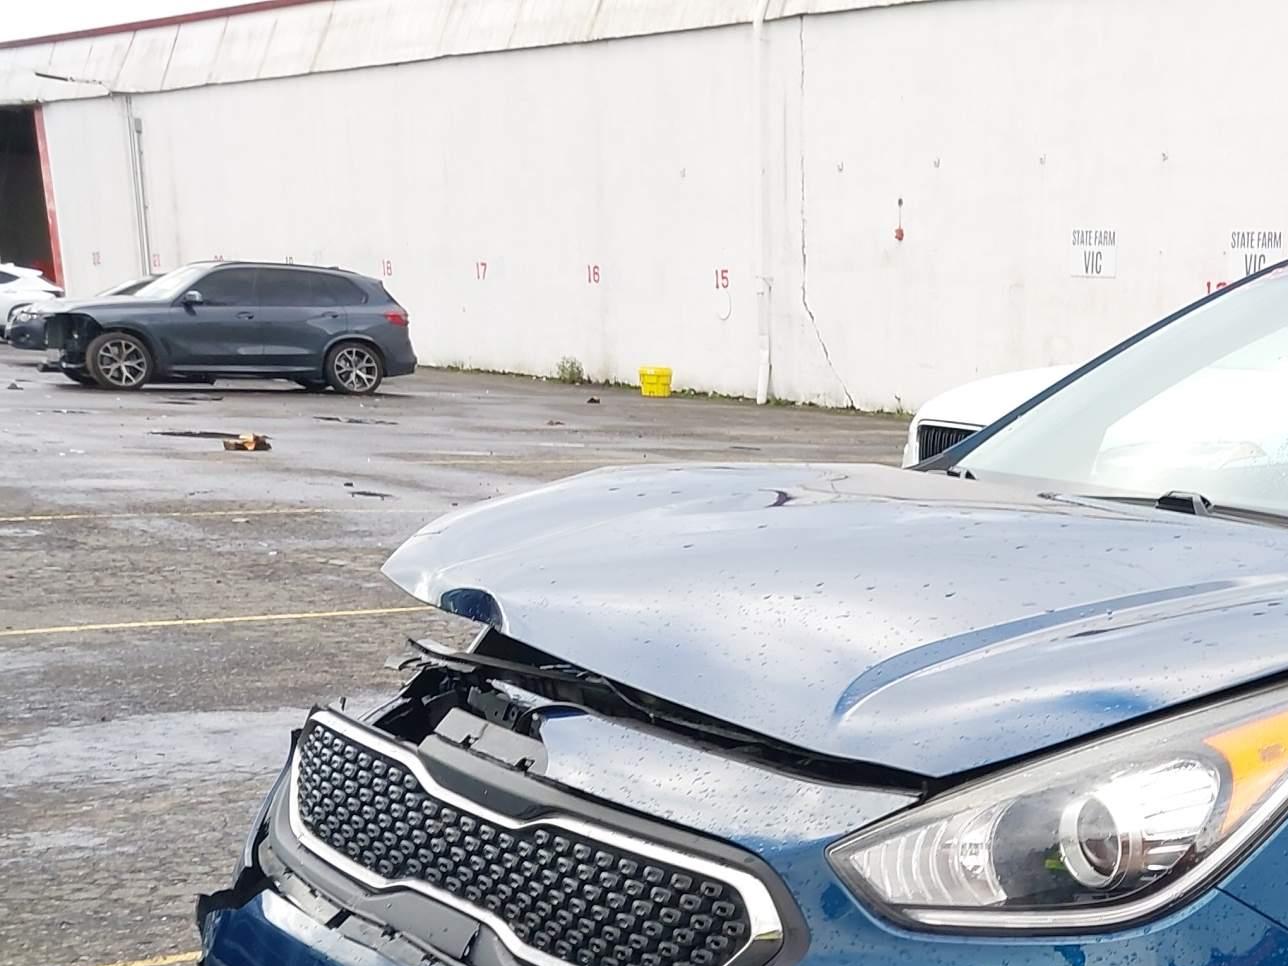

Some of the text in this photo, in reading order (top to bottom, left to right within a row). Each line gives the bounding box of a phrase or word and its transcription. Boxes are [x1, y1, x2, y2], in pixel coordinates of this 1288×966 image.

[1072, 230, 1116, 247] STATE FARM
[1231, 231, 1282, 249] STATE FARM
[382, 259, 393, 276] 18
[475, 262, 488, 280] 17
[1083, 251, 1102, 275] VIC
[587, 264, 600, 283] 16
[714, 269, 729, 289] 15
